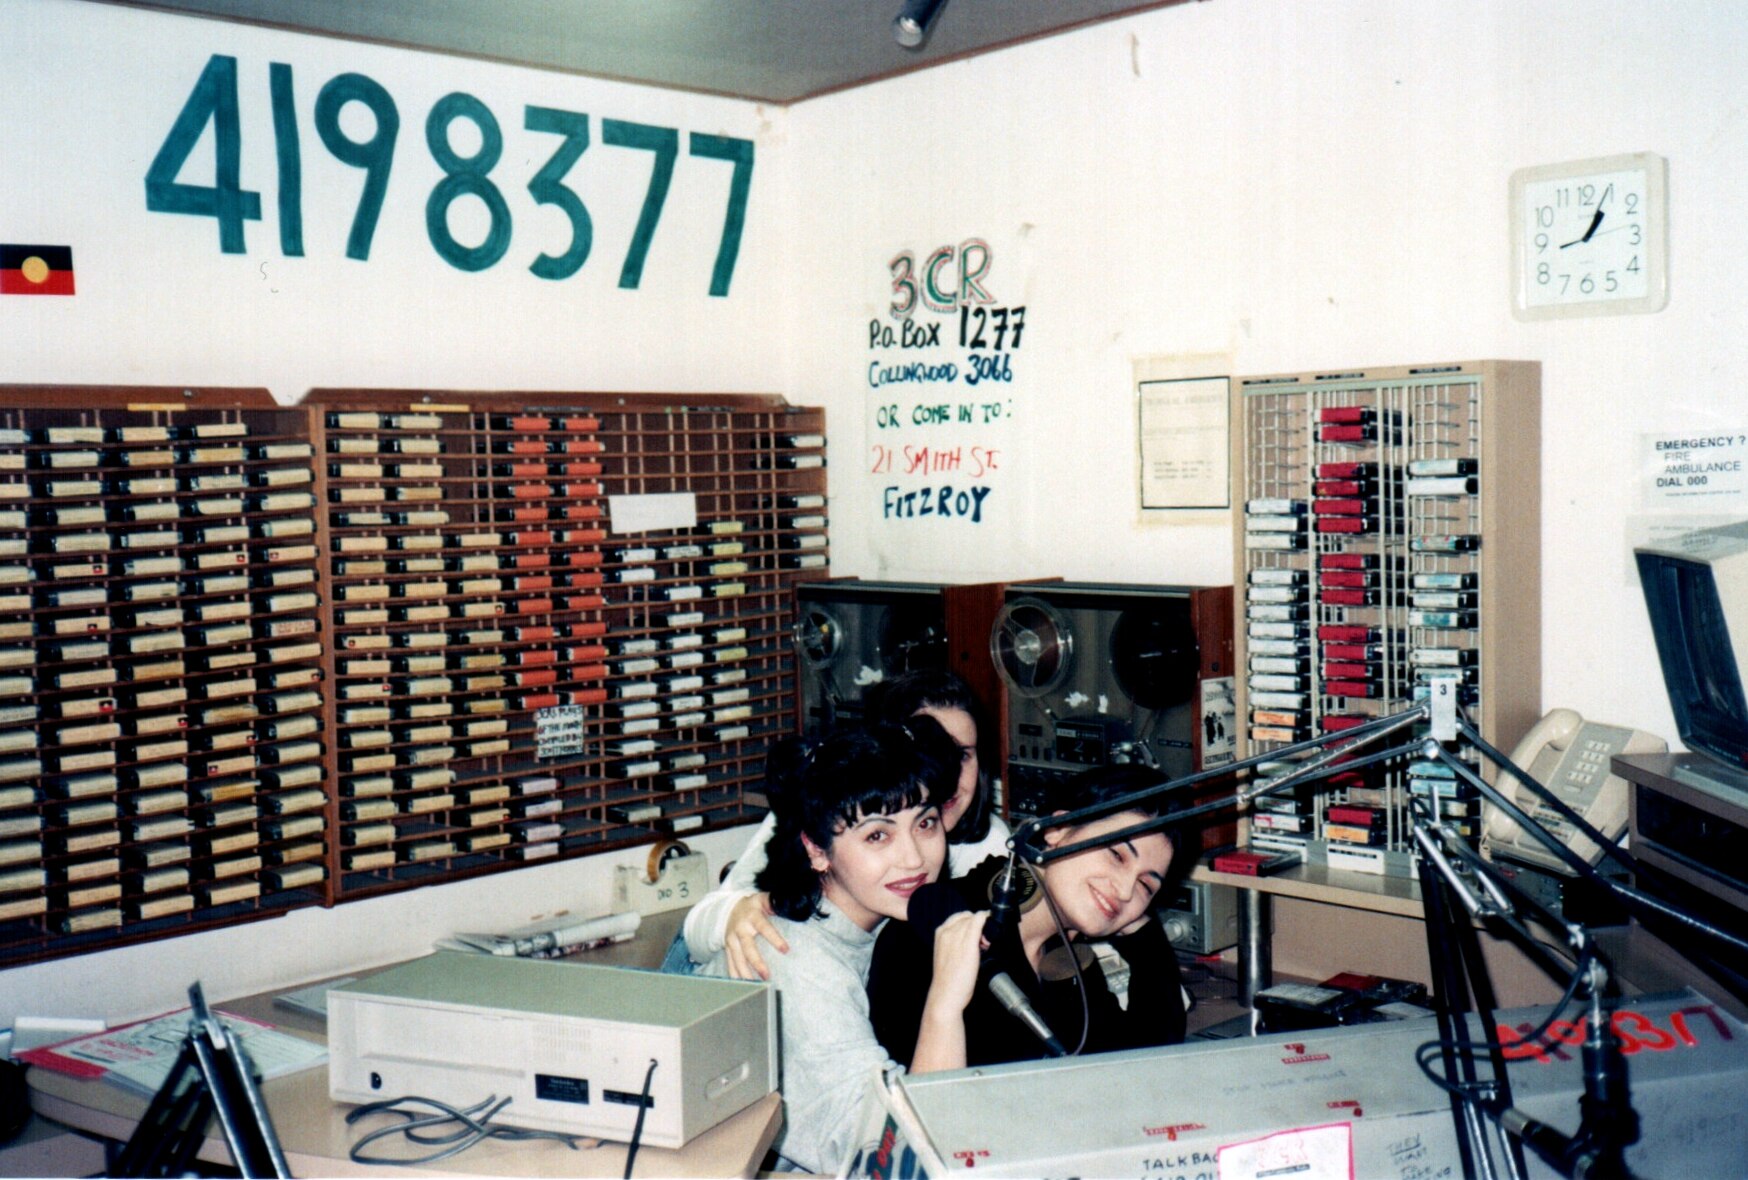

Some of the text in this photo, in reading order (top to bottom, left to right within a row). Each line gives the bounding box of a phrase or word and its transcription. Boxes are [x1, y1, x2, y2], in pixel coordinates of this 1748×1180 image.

[144, 54, 755, 297] 4198377
[1556, 188, 1570, 208] 11
[1577, 184, 1595, 207] 12
[1624, 193, 1638, 215] 2
[1535, 205, 1554, 228] 10
[1534, 233, 1549, 255] 9
[1629, 223, 1641, 246] 3
[1536, 262, 1550, 285] 8
[1626, 255, 1640, 275] 4
[889, 237, 997, 320] 3CR
[1558, 274, 1571, 295] 7
[1579, 272, 1595, 294] 6
[1605, 270, 1618, 292] 5
[959, 305, 1026, 351] 1277
[965, 352, 1012, 386] 3066
[876, 404, 900, 429] OR
[912, 404, 951, 425] COME
[958, 402, 974, 424] IN
[1656, 435, 1746, 451] EMERGENCY ?
[871, 444, 1000, 478] 21 SMITH ST.
[1664, 451, 1692, 462] FIRE
[1665, 461, 1741, 474] AMBULANCE
[1656, 475, 1708, 488] DIAL 000
[883, 485, 991, 523] FITZROY
[1440, 683, 1448, 696] 3
[677, 881, 689, 898] 3
